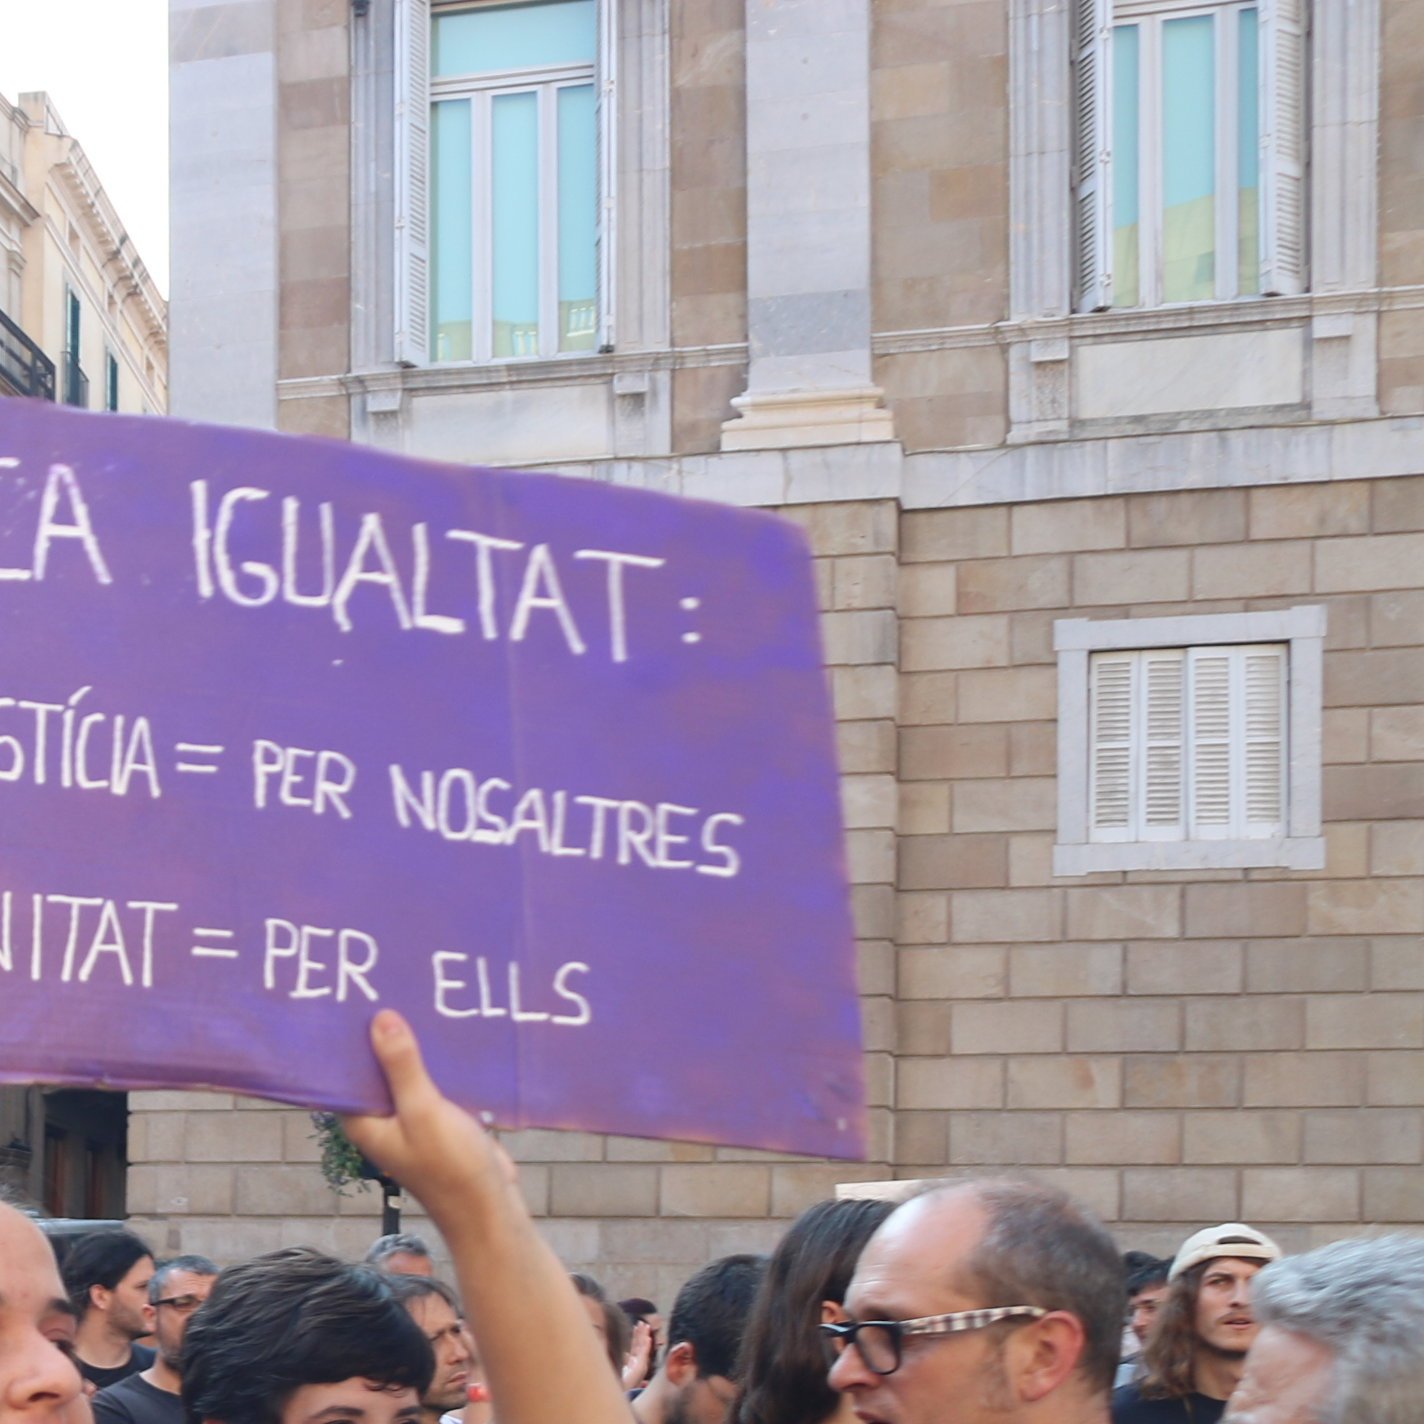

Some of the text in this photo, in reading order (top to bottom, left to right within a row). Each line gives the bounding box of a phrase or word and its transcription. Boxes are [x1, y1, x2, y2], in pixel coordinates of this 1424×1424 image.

[252, 737, 355, 820] PER
[389, 762, 746, 878] NOSALTRES
[263, 917, 380, 1002] PER
[431, 950, 593, 1026] ELLS
